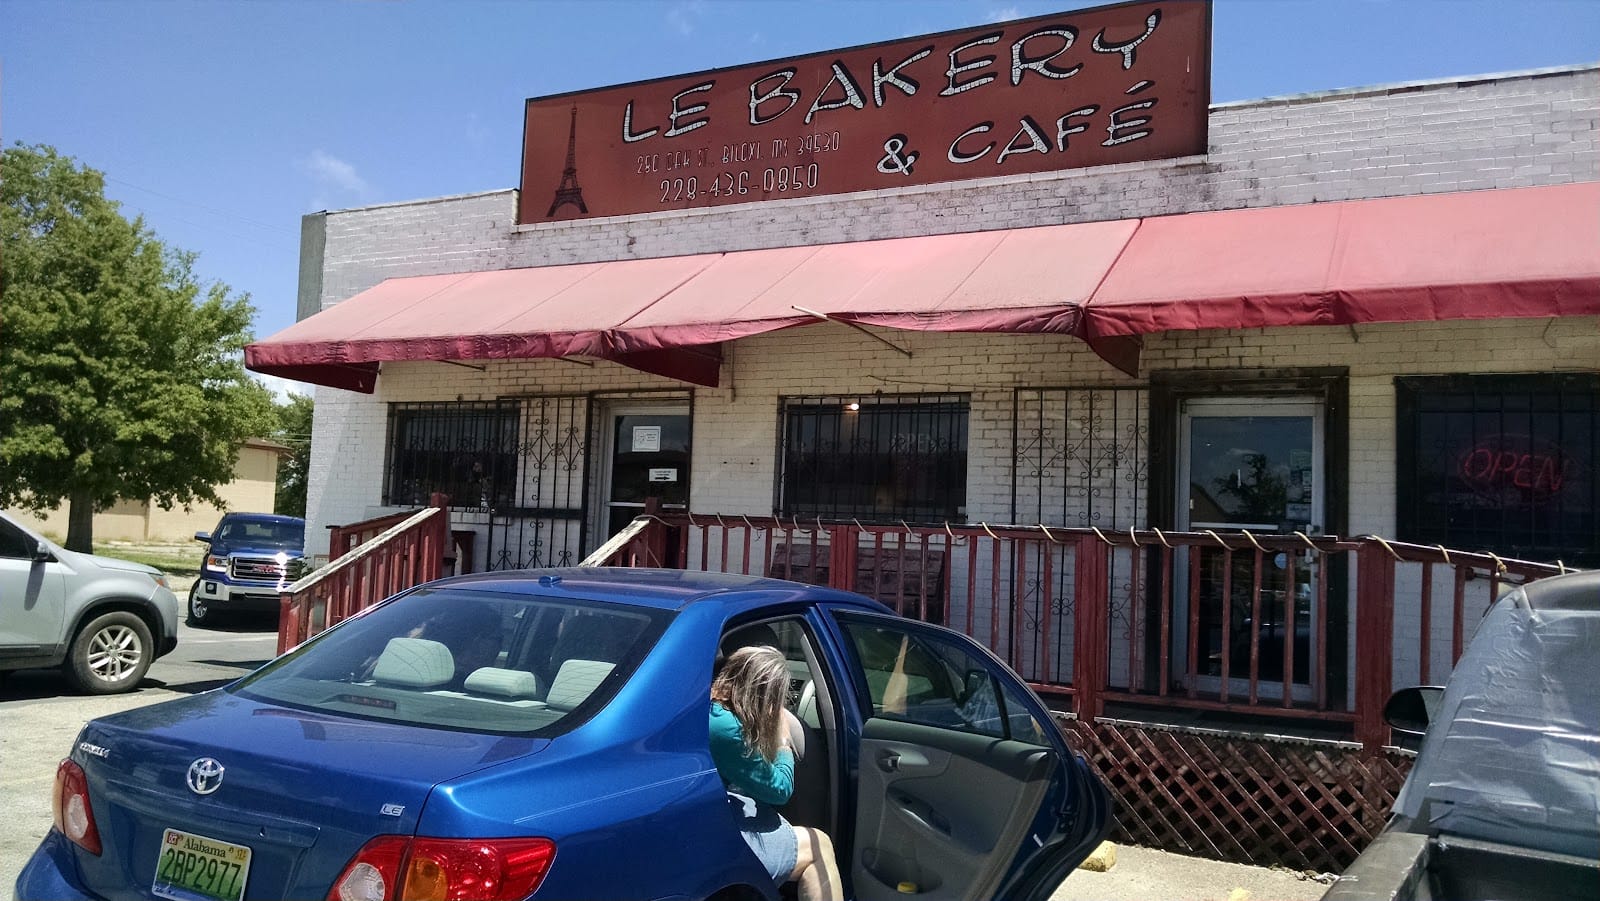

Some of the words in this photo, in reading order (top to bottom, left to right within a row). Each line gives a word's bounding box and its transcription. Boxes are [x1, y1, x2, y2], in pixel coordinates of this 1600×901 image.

[621, 80, 716, 143] LE
[749, 9, 1162, 125] BAKERY
[771, 137, 788, 159] MS
[797, 131, 840, 156] 39530
[876, 134, 920, 176] &
[947, 80, 1158, 165] CAFÉ
[660, 162, 819, 204] 228-436-0850
[1463, 448, 1571, 491] OPEN
[381, 804, 403, 815] LE
[183, 837, 227, 858] Alabama
[161, 848, 242, 898] 2BP2977
